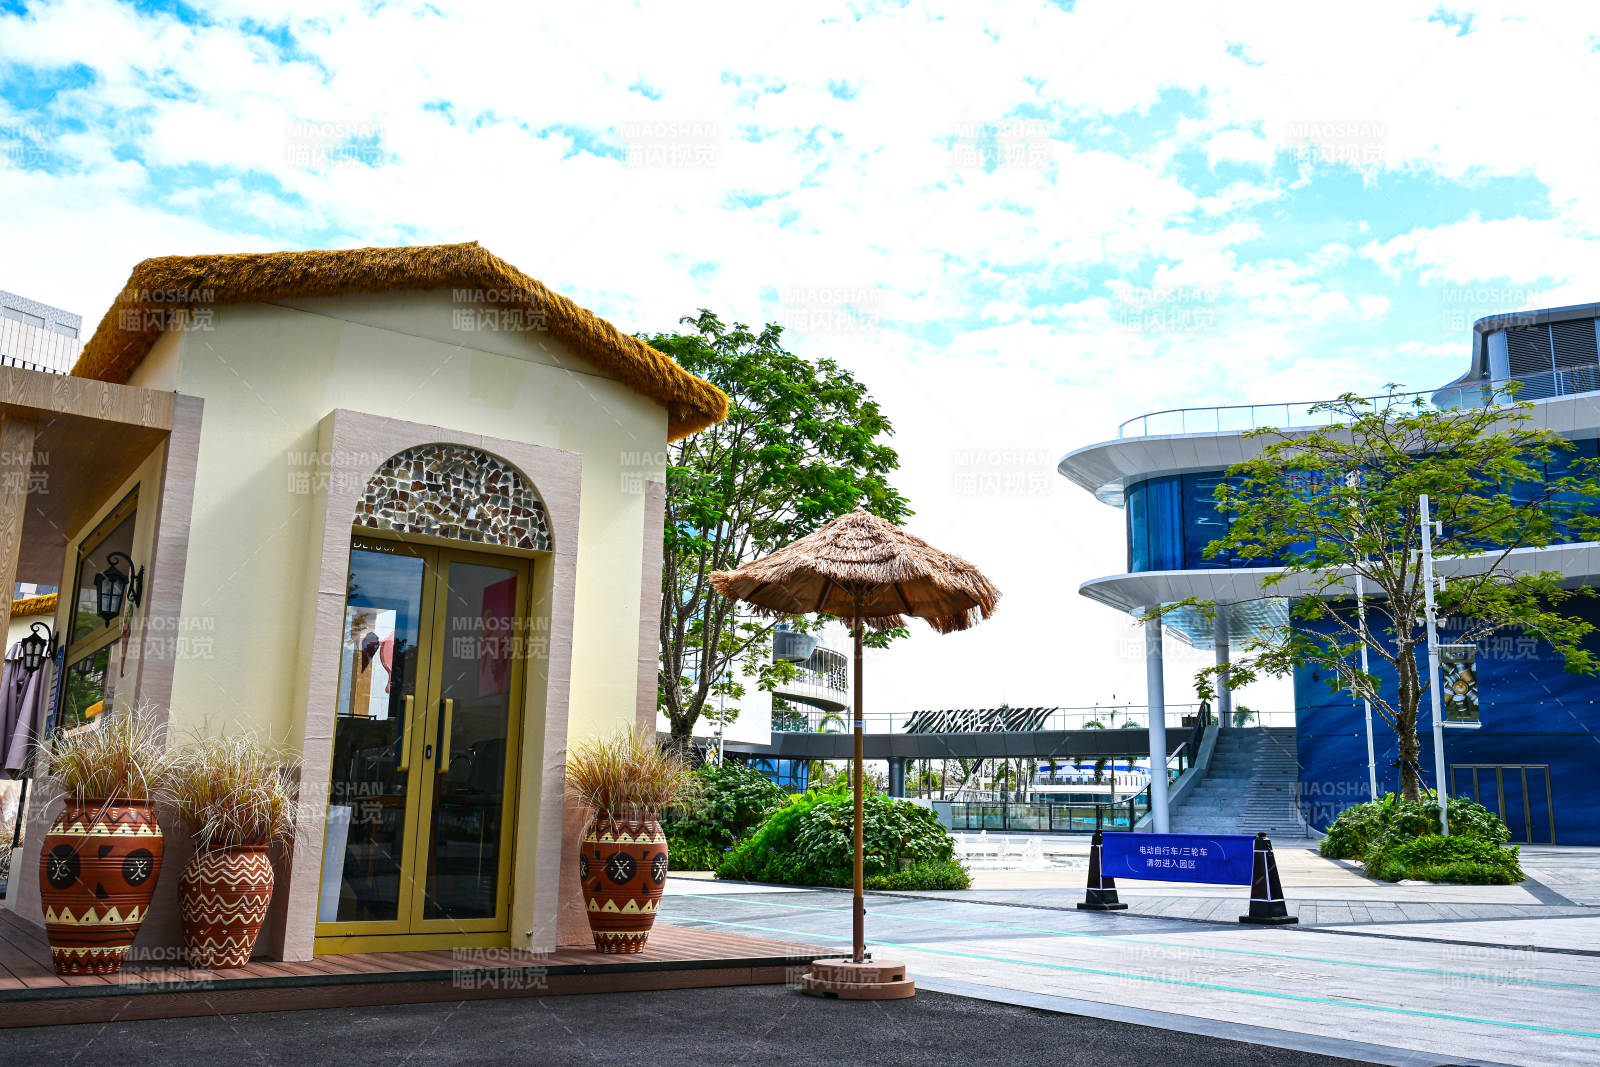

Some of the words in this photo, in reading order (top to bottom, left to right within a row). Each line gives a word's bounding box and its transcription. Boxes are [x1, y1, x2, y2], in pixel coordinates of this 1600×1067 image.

[1139, 846, 1208, 857] 电动自行车/三轮车
[1146, 858, 1196, 869] 请勿进入园区
